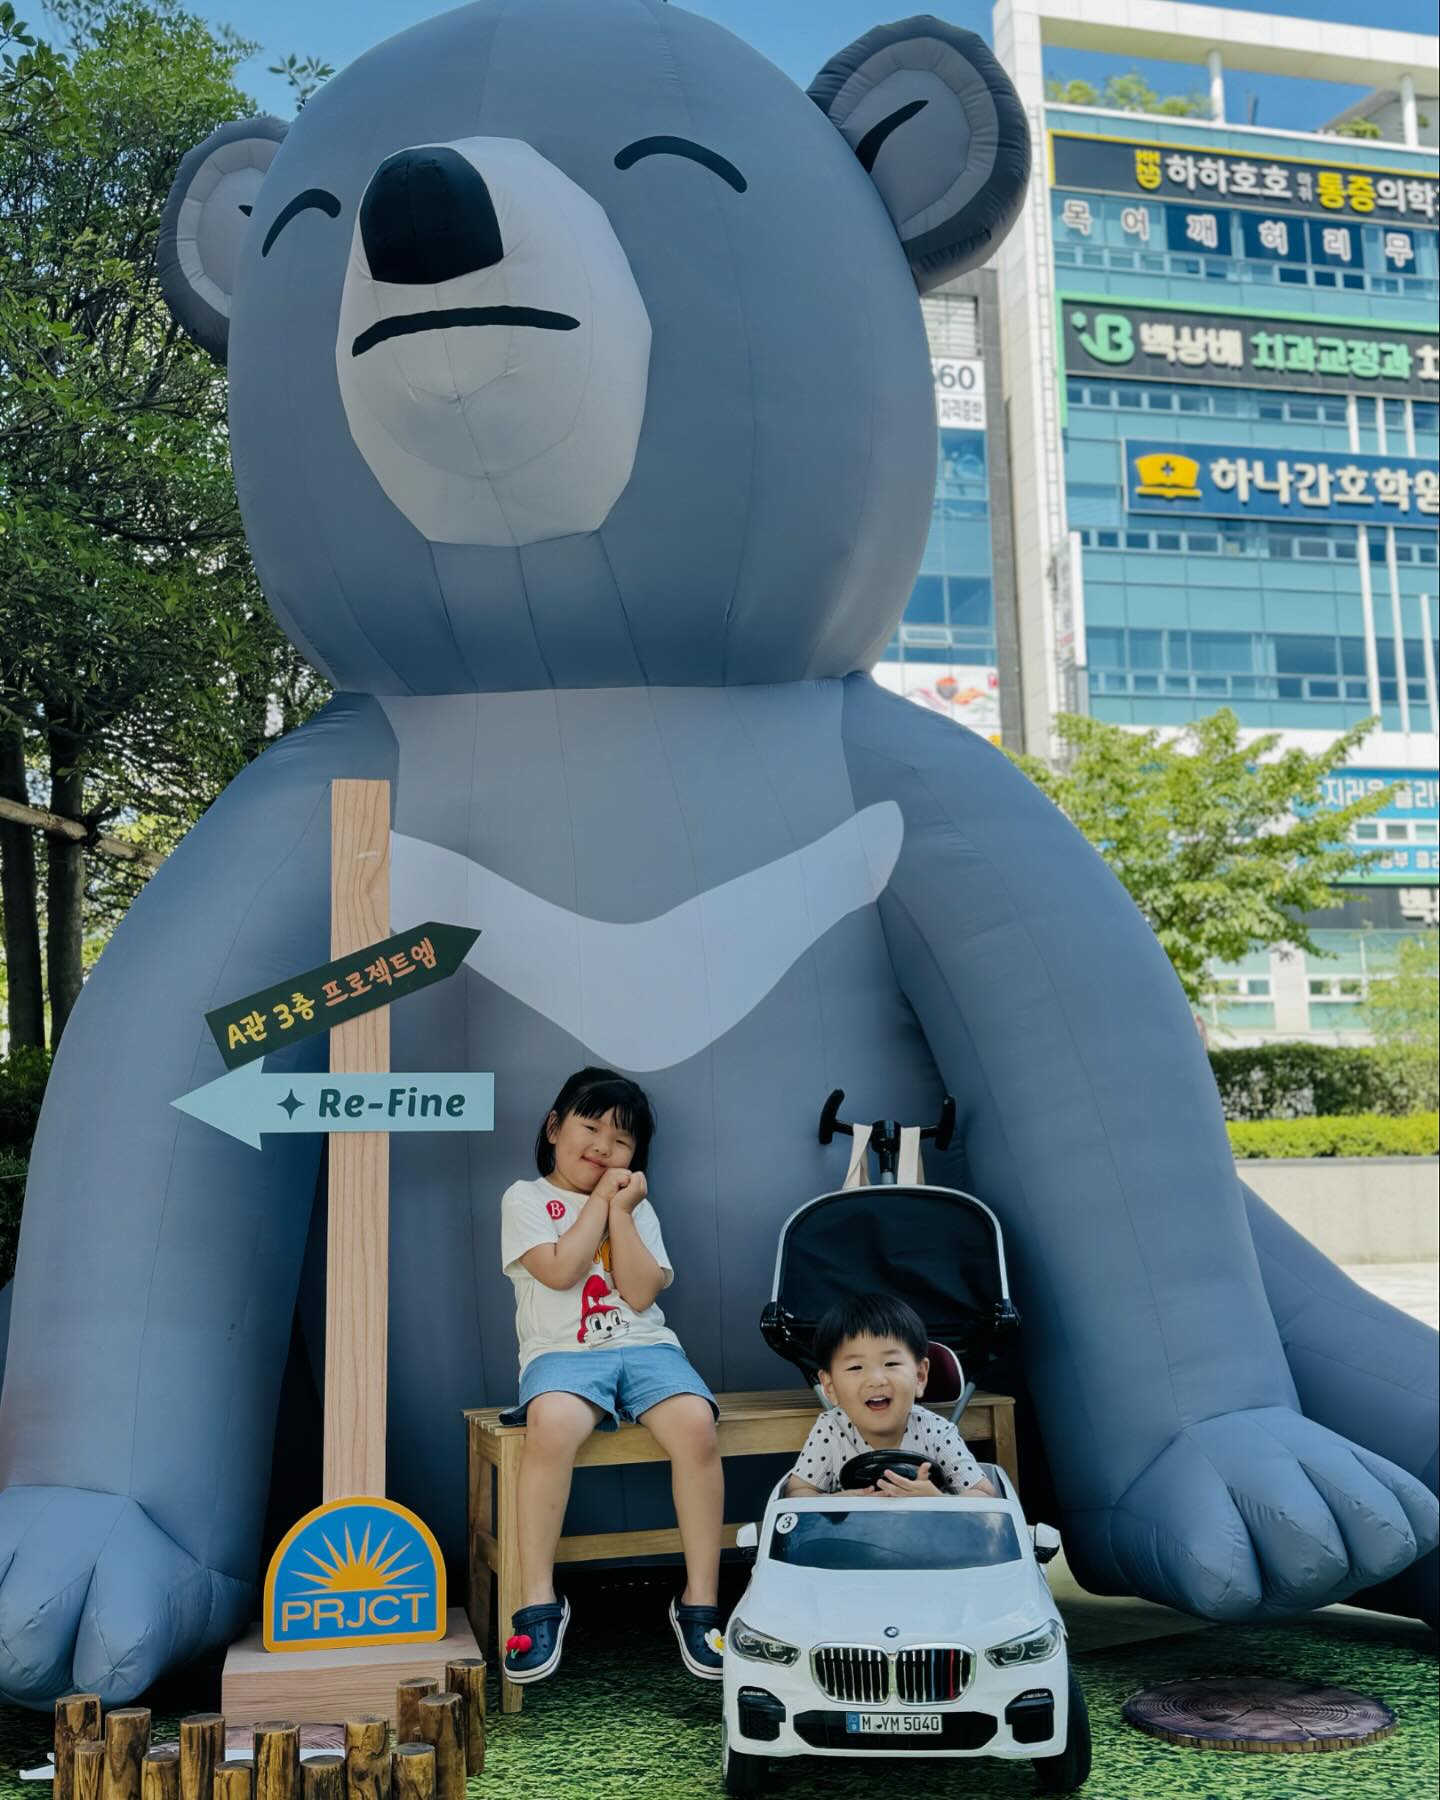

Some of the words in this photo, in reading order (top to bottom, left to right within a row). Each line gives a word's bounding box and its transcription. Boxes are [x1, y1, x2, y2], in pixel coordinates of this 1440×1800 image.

[1165, 153, 1292, 199] 하하호호
[1250, 331, 1414, 379] 치과교정과
[1209, 457, 1439, 514] 하나간호학원
[226, 1009, 268, 1050] A관
[271, 992, 316, 1030] 3층
[321, 936, 437, 1007] 프로젝트엠
[318, 1086, 467, 1119] Re-Fine
[280, 1592, 430, 1633] PRJCT
[903, 1716, 940, 1731] 5040
